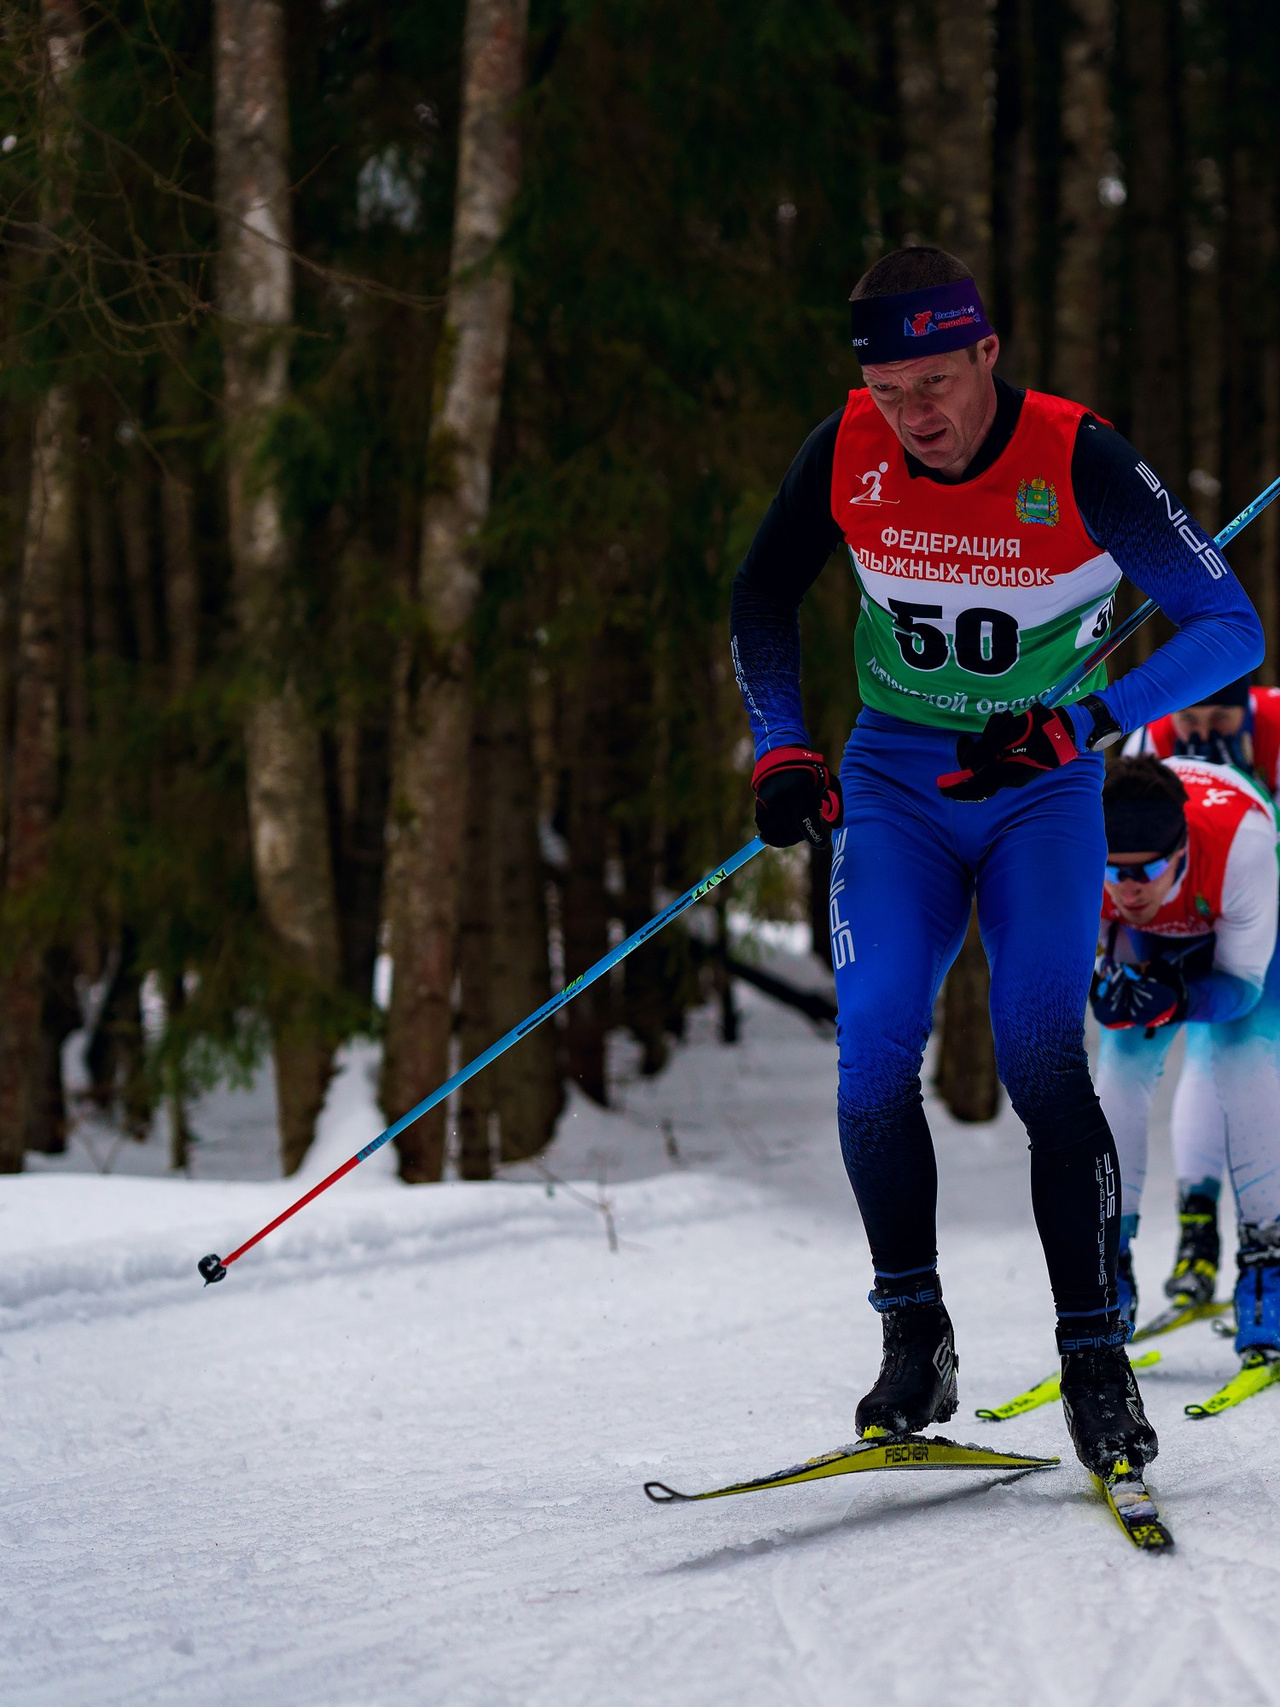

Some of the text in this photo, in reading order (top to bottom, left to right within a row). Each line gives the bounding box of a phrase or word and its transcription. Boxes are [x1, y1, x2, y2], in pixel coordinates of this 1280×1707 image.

[1134, 460, 1228, 580] SPINE
[880, 526, 1021, 559] ФЕДЕРАЦИЯ
[857, 547, 1052, 586] ЛЫЖНЫХ ГОНОК
[887, 597, 1020, 677] 50
[829, 827, 856, 970] SPINE
[1103, 1152, 1116, 1219] SCF
[875, 1288, 936, 1311] SPINE
[1060, 1330, 1125, 1351] SPINE
[884, 1446, 929, 1464] FISCHER
